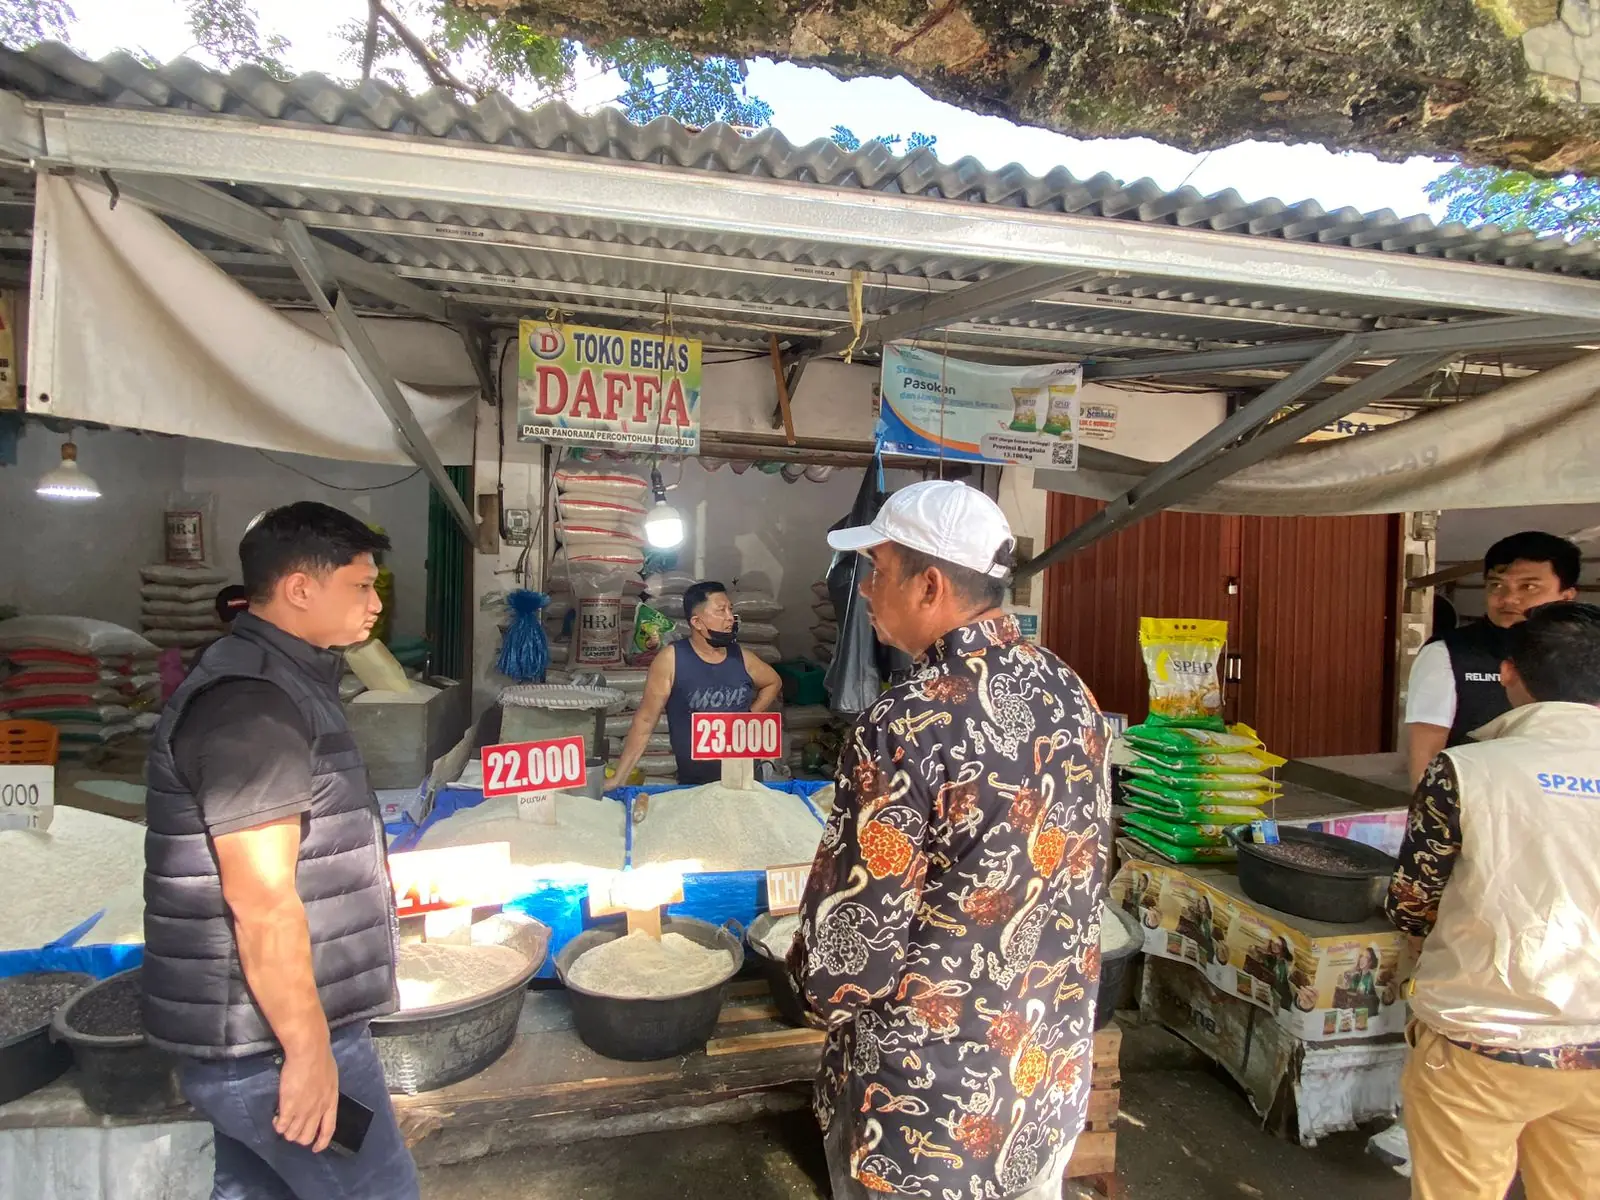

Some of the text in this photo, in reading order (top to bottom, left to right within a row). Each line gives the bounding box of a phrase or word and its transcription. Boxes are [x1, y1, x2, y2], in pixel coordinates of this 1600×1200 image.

[540, 333, 559, 353] D
[573, 333, 689, 373] TOKO BERAS
[535, 365, 690, 427] DAFFA
[903, 377, 956, 396] Pasokan
[524, 425, 695, 447] PASAR PANORAMA PERCONTOHAN BENGKULU
[582, 614, 617, 629] HRJ
[1173, 660, 1213, 674] SPHP
[1465, 672, 1502, 682] RELINT
[696, 719, 777, 754] 23.000
[487, 743, 581, 790] 22.000
[520, 794, 548, 805] DUSUN
